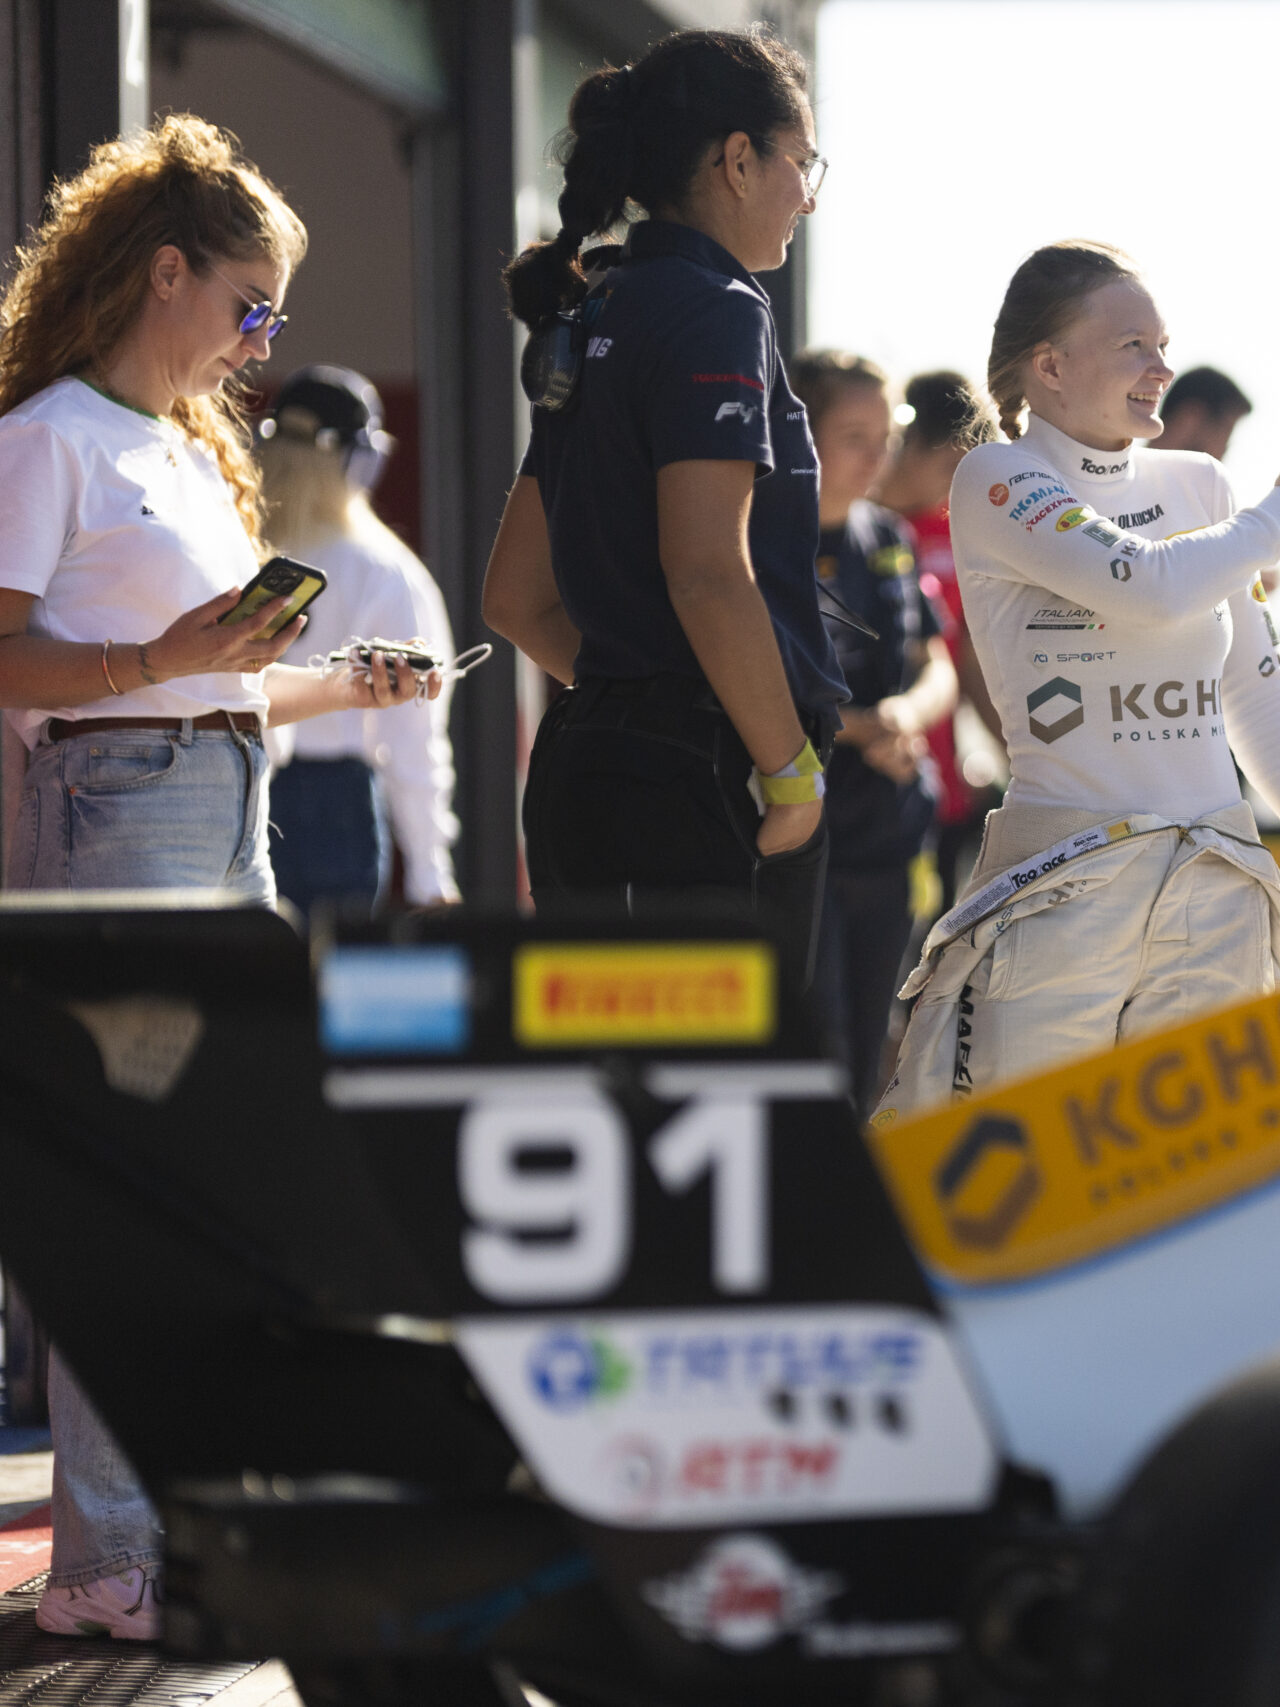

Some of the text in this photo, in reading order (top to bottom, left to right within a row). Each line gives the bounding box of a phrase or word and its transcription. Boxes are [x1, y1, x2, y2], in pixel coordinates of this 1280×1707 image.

[714, 401, 757, 424] F4
[1118, 503, 1165, 530] OLKUCKA
[1034, 609, 1095, 618] ITALIAN
[1057, 651, 1117, 662] SPORT
[1113, 728, 1200, 742] POLSKA
[457, 1084, 770, 1304] 91
